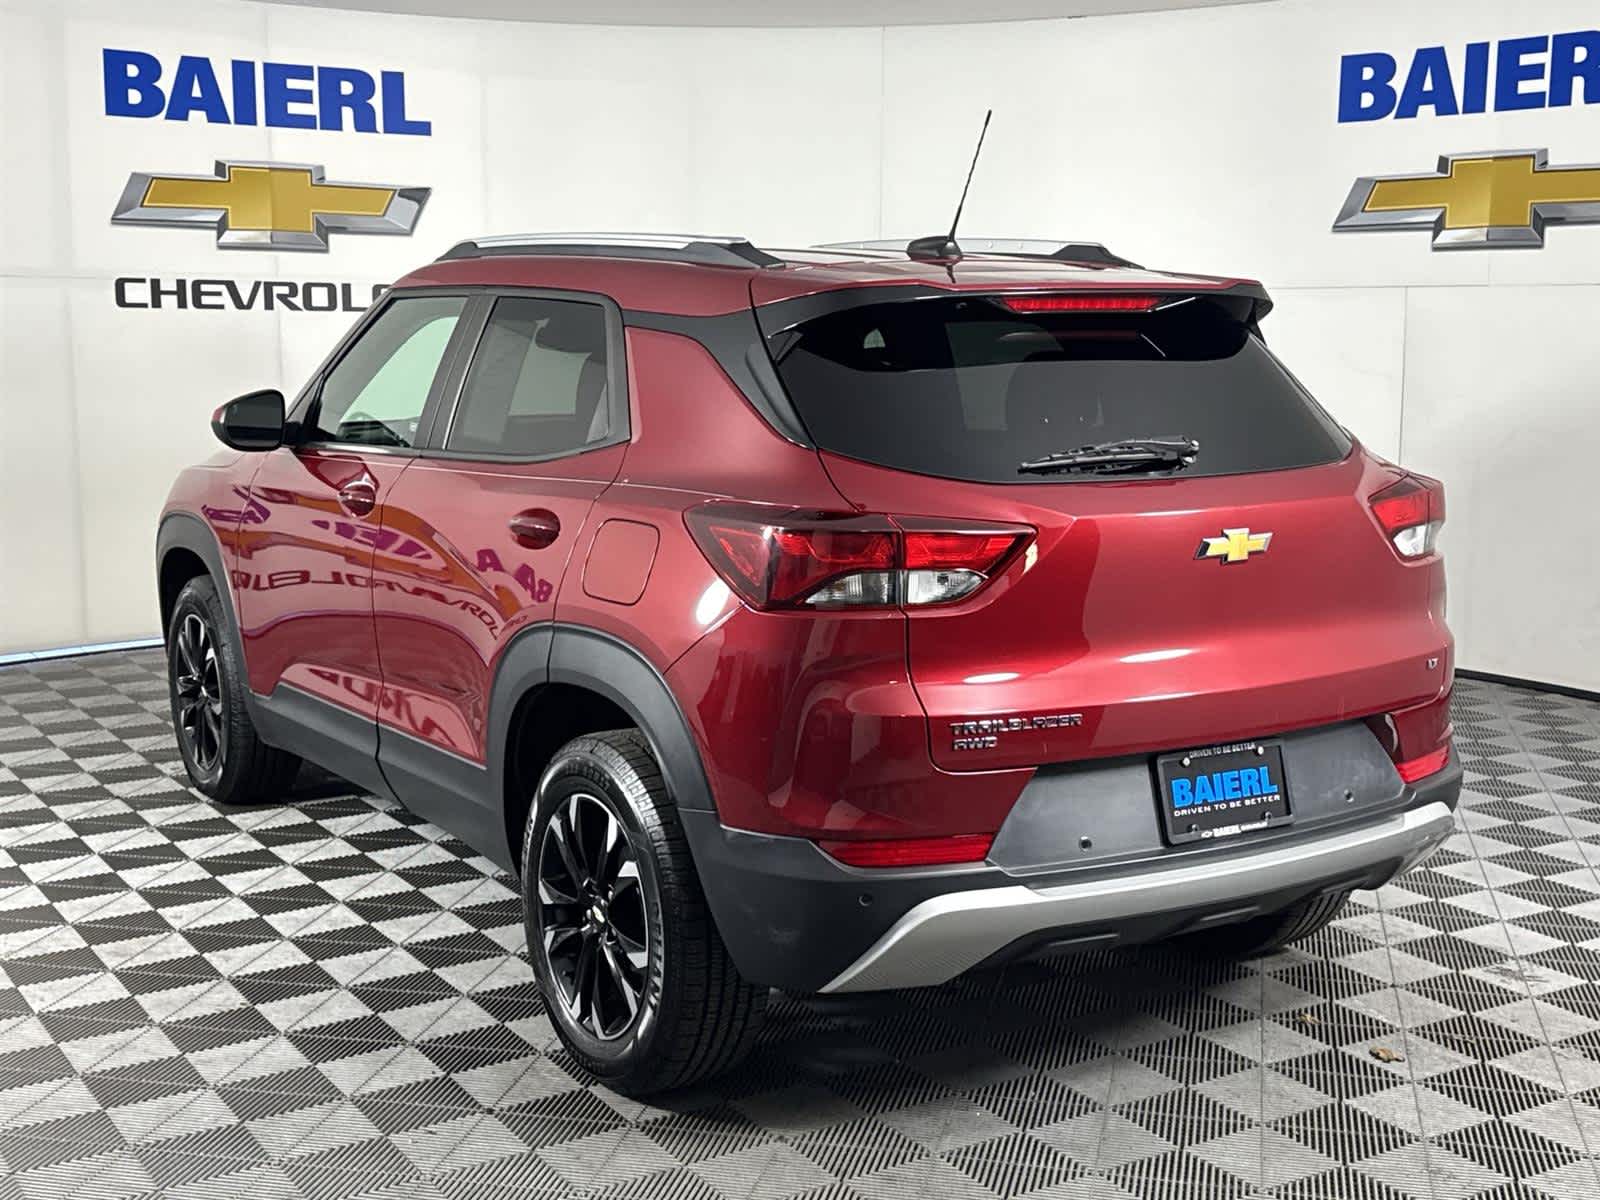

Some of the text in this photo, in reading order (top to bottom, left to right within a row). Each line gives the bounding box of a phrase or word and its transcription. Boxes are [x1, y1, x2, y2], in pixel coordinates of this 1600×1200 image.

[102, 48, 432, 136] BAIERL
[1338, 30, 1600, 123] BAIER
[951, 713, 1083, 735] TRAILBLAZER
[1172, 766, 1278, 808] BAIERL
[1174, 805, 1211, 817] DRIVEN
[1214, 803, 1227, 811] TO
[1244, 795, 1280, 806] BETTER
